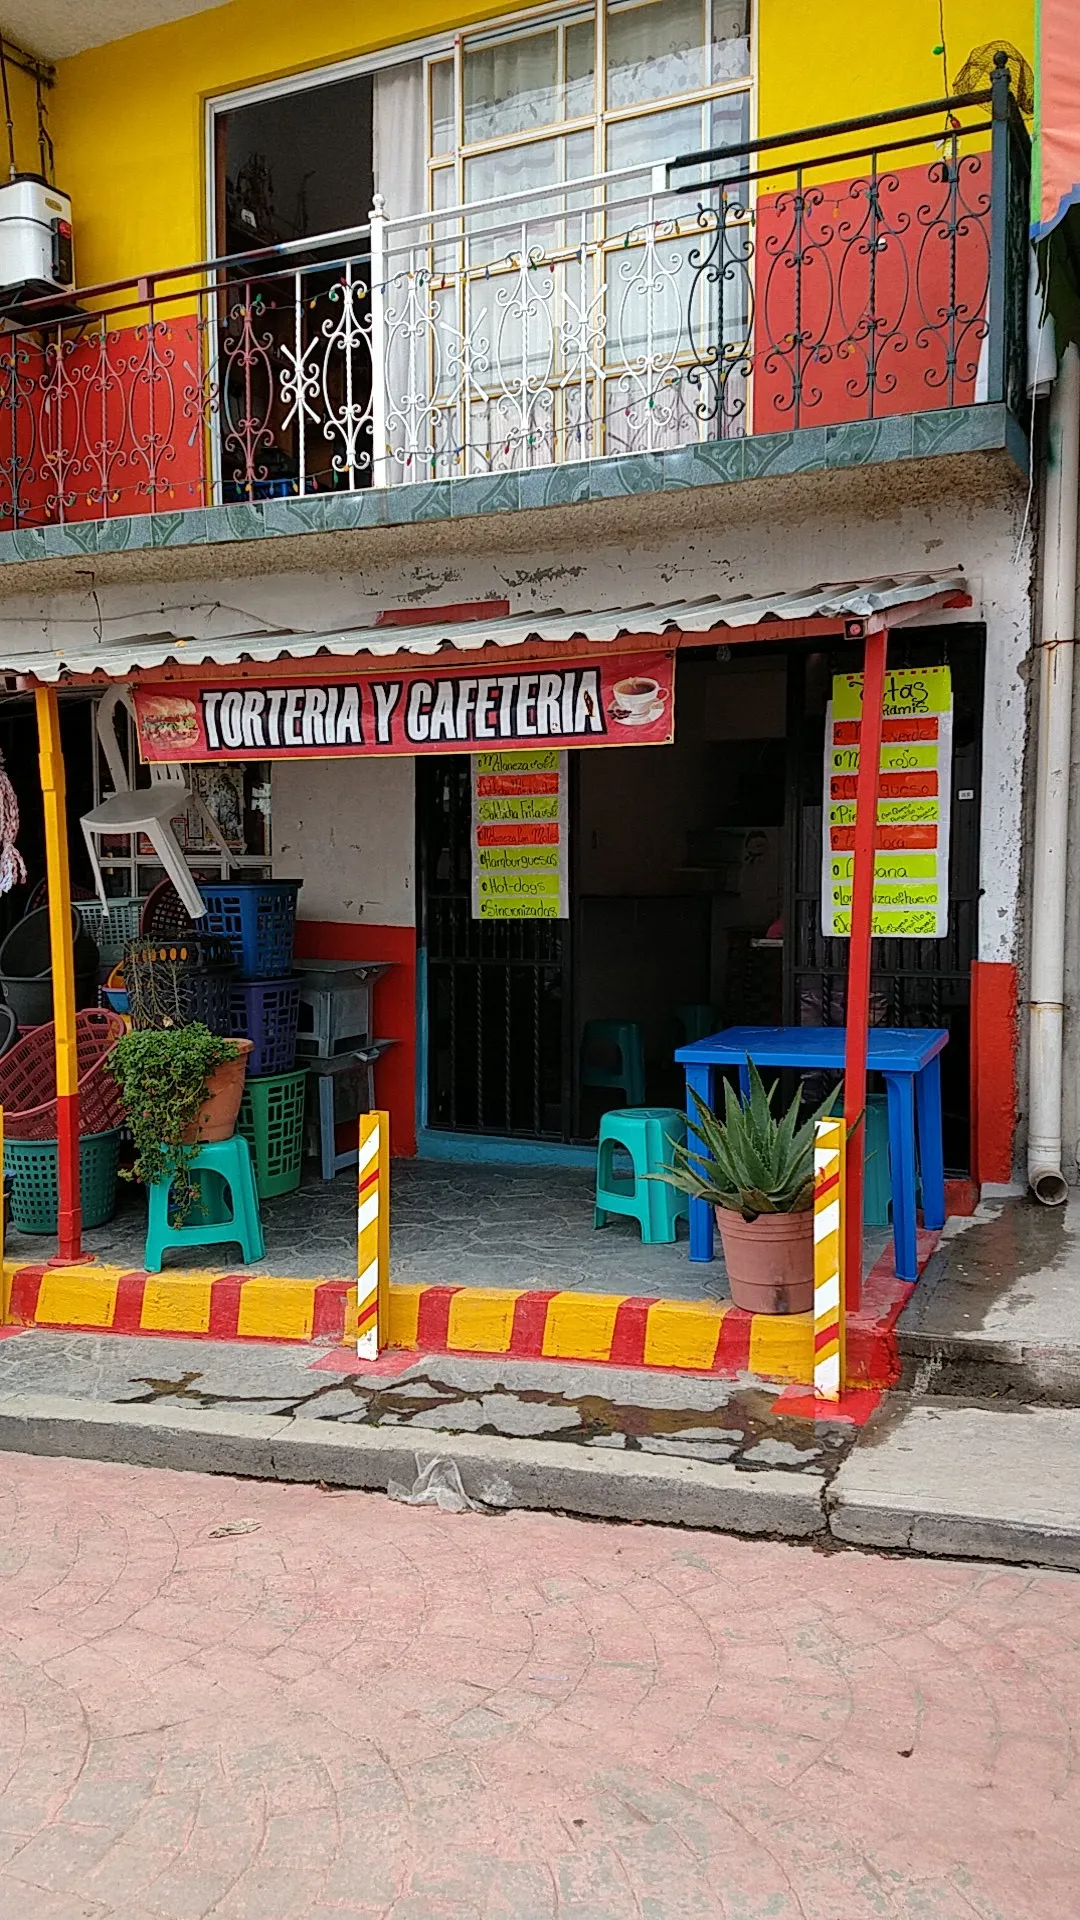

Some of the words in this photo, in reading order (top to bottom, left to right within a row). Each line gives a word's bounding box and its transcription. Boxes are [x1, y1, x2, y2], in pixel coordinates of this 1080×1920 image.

[201, 685, 363, 749] TORTERIA
[371, 682, 401, 743] Y
[406, 670, 604, 741] CAFETERIA
[890, 721, 931, 740] verde
[889, 749, 918, 768] rojo
[836, 805, 880, 823] Pie
[483, 849, 558, 869] Hamburguesas
[846, 857, 908, 877] Cana
[489, 876, 546, 895] Hot-dogs
[839, 885, 891, 906] Loiza
[903, 890, 938, 904] huevo
[485, 899, 558, 918] Sincronizadas
